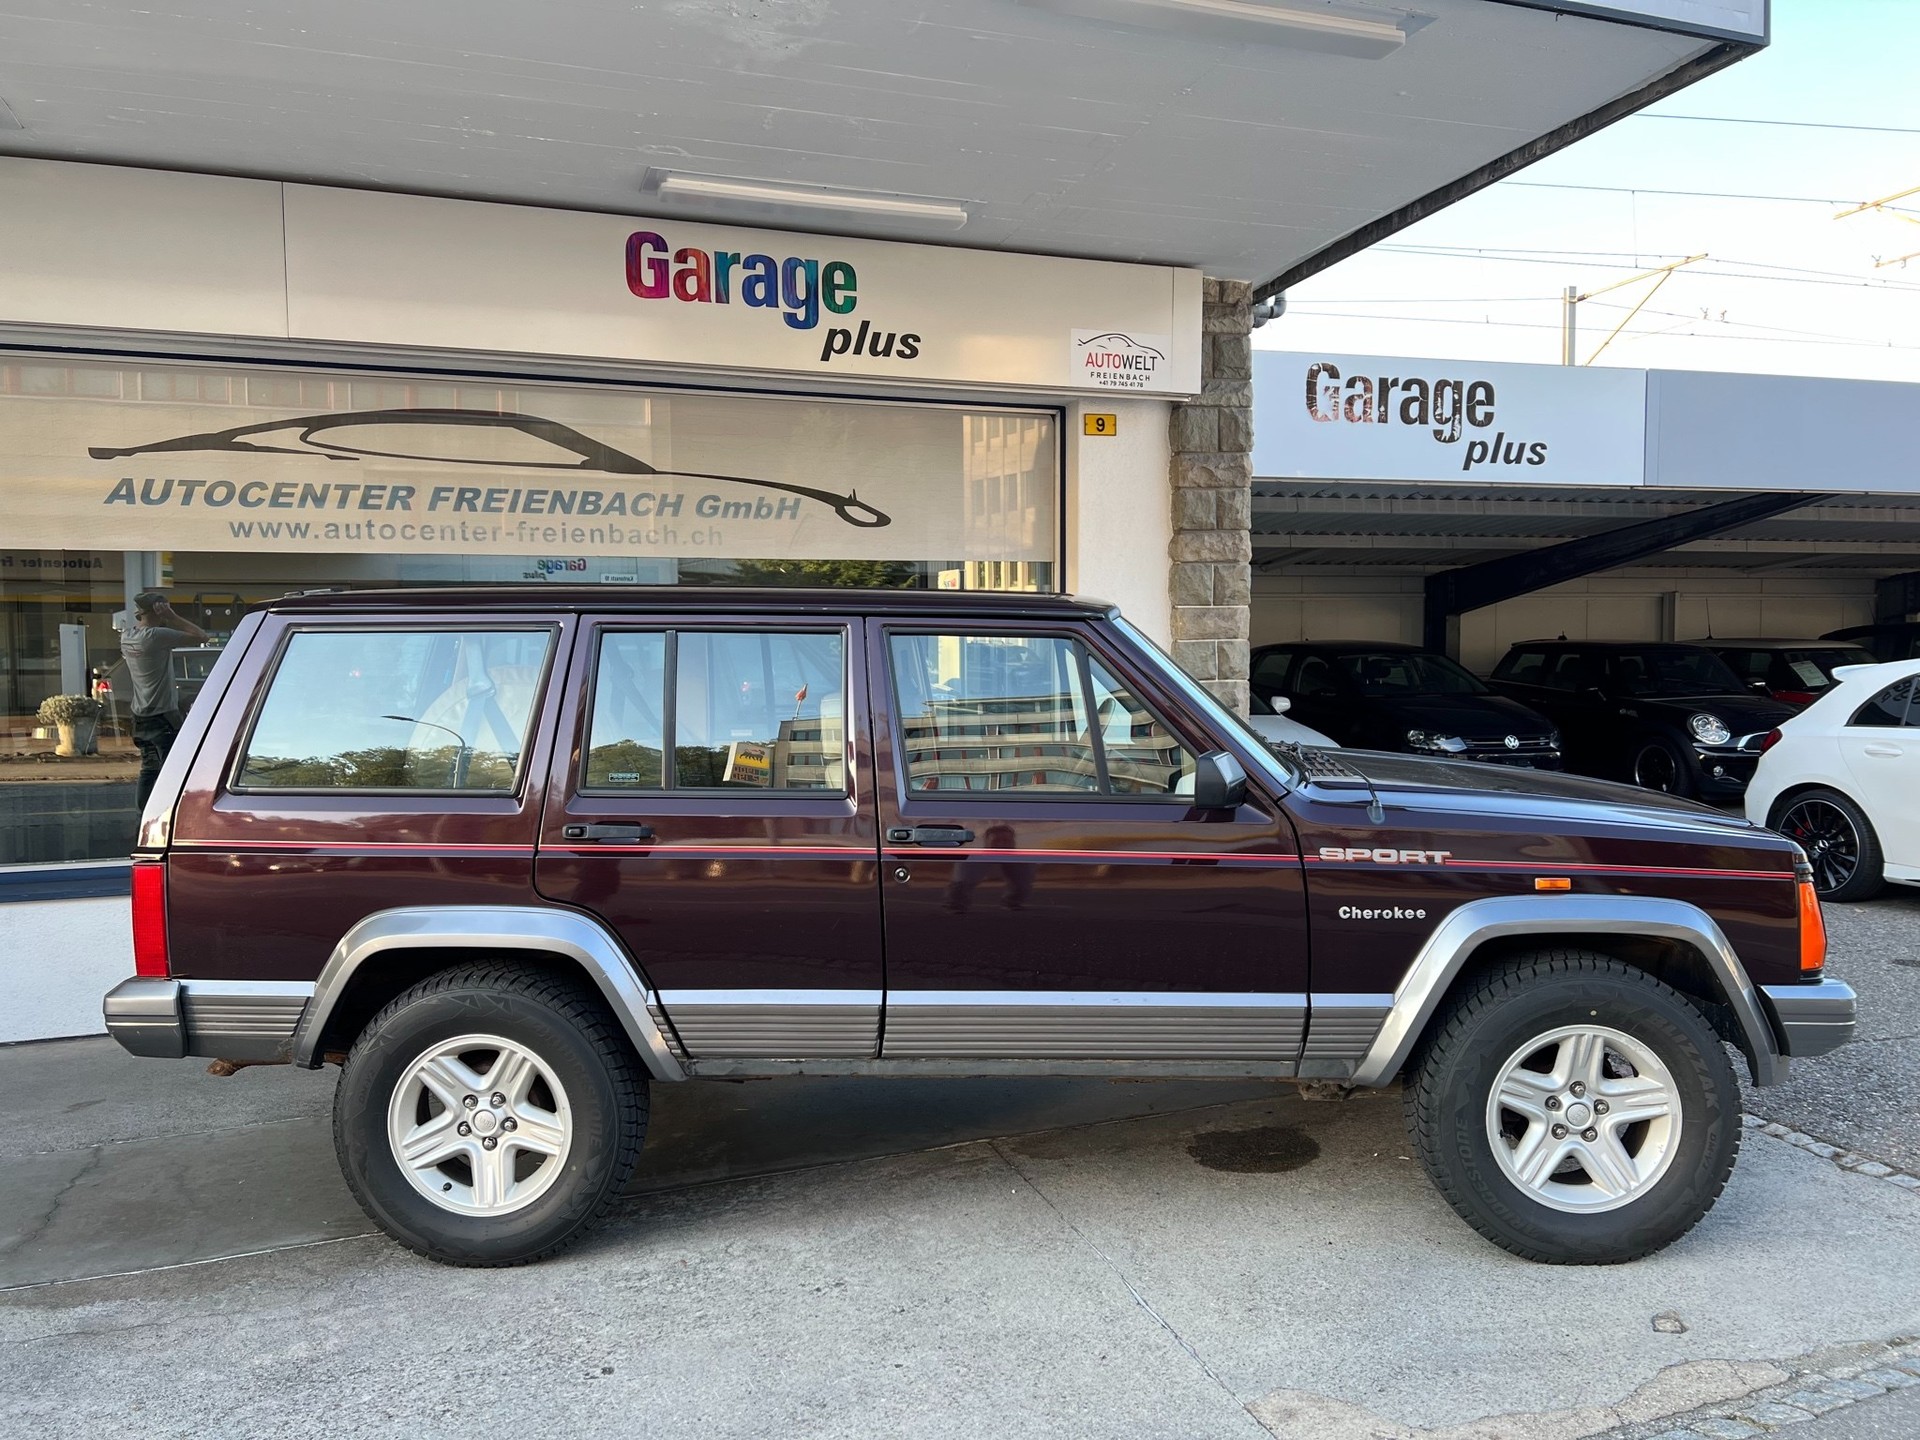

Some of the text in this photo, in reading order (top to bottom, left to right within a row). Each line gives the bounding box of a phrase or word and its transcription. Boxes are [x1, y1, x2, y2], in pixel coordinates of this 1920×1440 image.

[625, 231, 858, 330] Garage
[820, 320, 921, 362] plus
[1085, 352, 1158, 371] AUTOWELT
[1090, 371, 1151, 382] FREIENBACH
[1305, 362, 1496, 443] Garage
[1095, 417, 1105, 432] 9
[1462, 432, 1548, 471] plus
[103, 477, 802, 521] AUTOCENTER FREIENBACH GmbH
[229, 520, 723, 547] www.autocenter-freienbach.ch
[1319, 847, 1452, 865] SPORT
[1338, 906, 1426, 919] Cherokee
[1650, 1011, 1721, 1111] BLIZZAK
